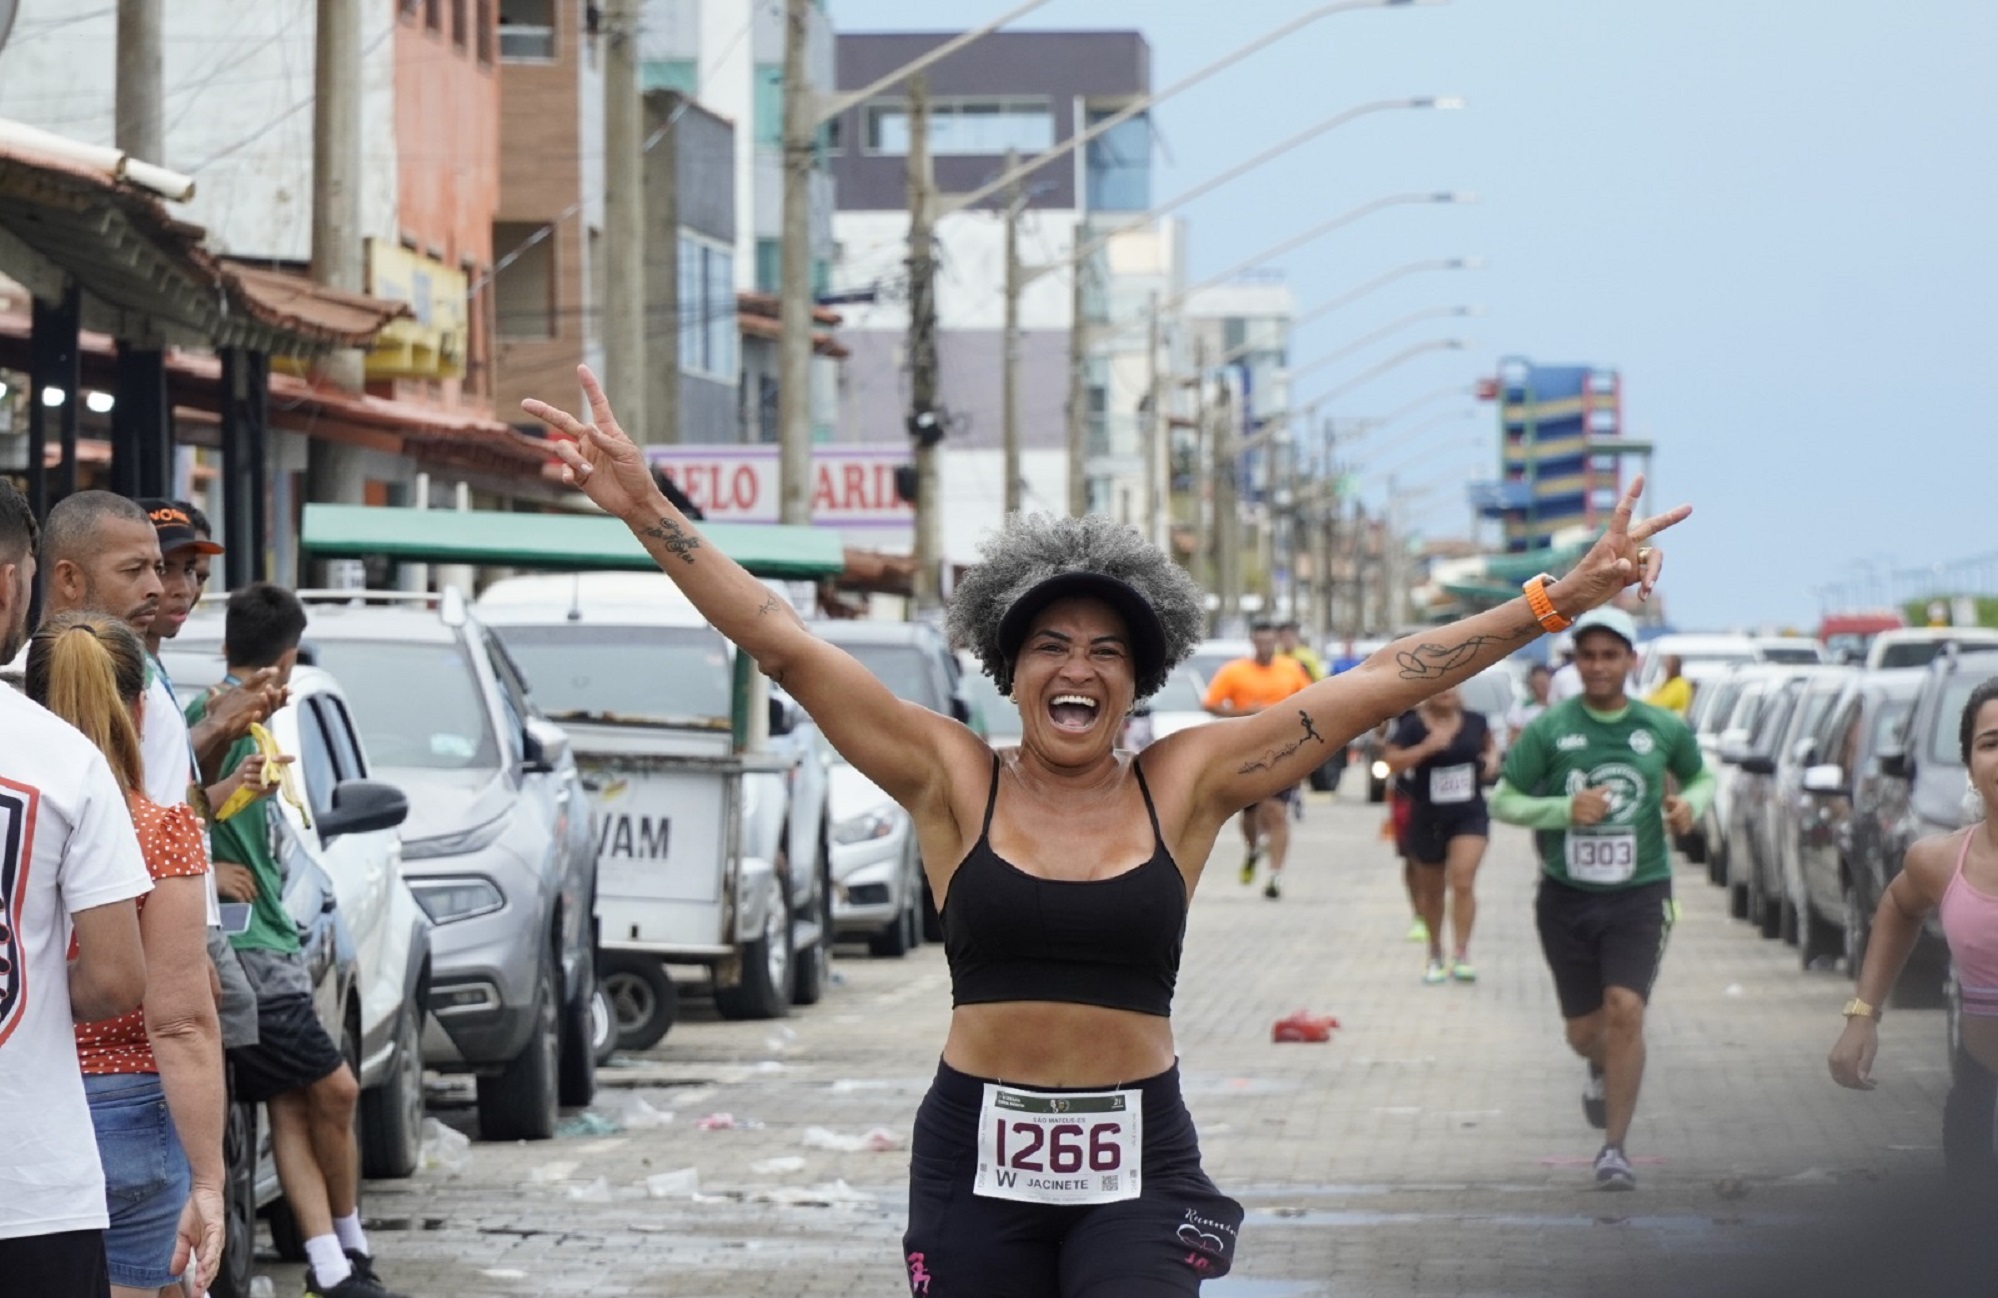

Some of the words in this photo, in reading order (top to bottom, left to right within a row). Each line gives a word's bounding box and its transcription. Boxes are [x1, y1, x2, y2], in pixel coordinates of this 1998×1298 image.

[1574, 841, 1632, 866] 1303
[996, 1118, 1121, 1174] 1266
[996, 1169, 1017, 1188] W
[1027, 1178, 1089, 1191] JACINETE
